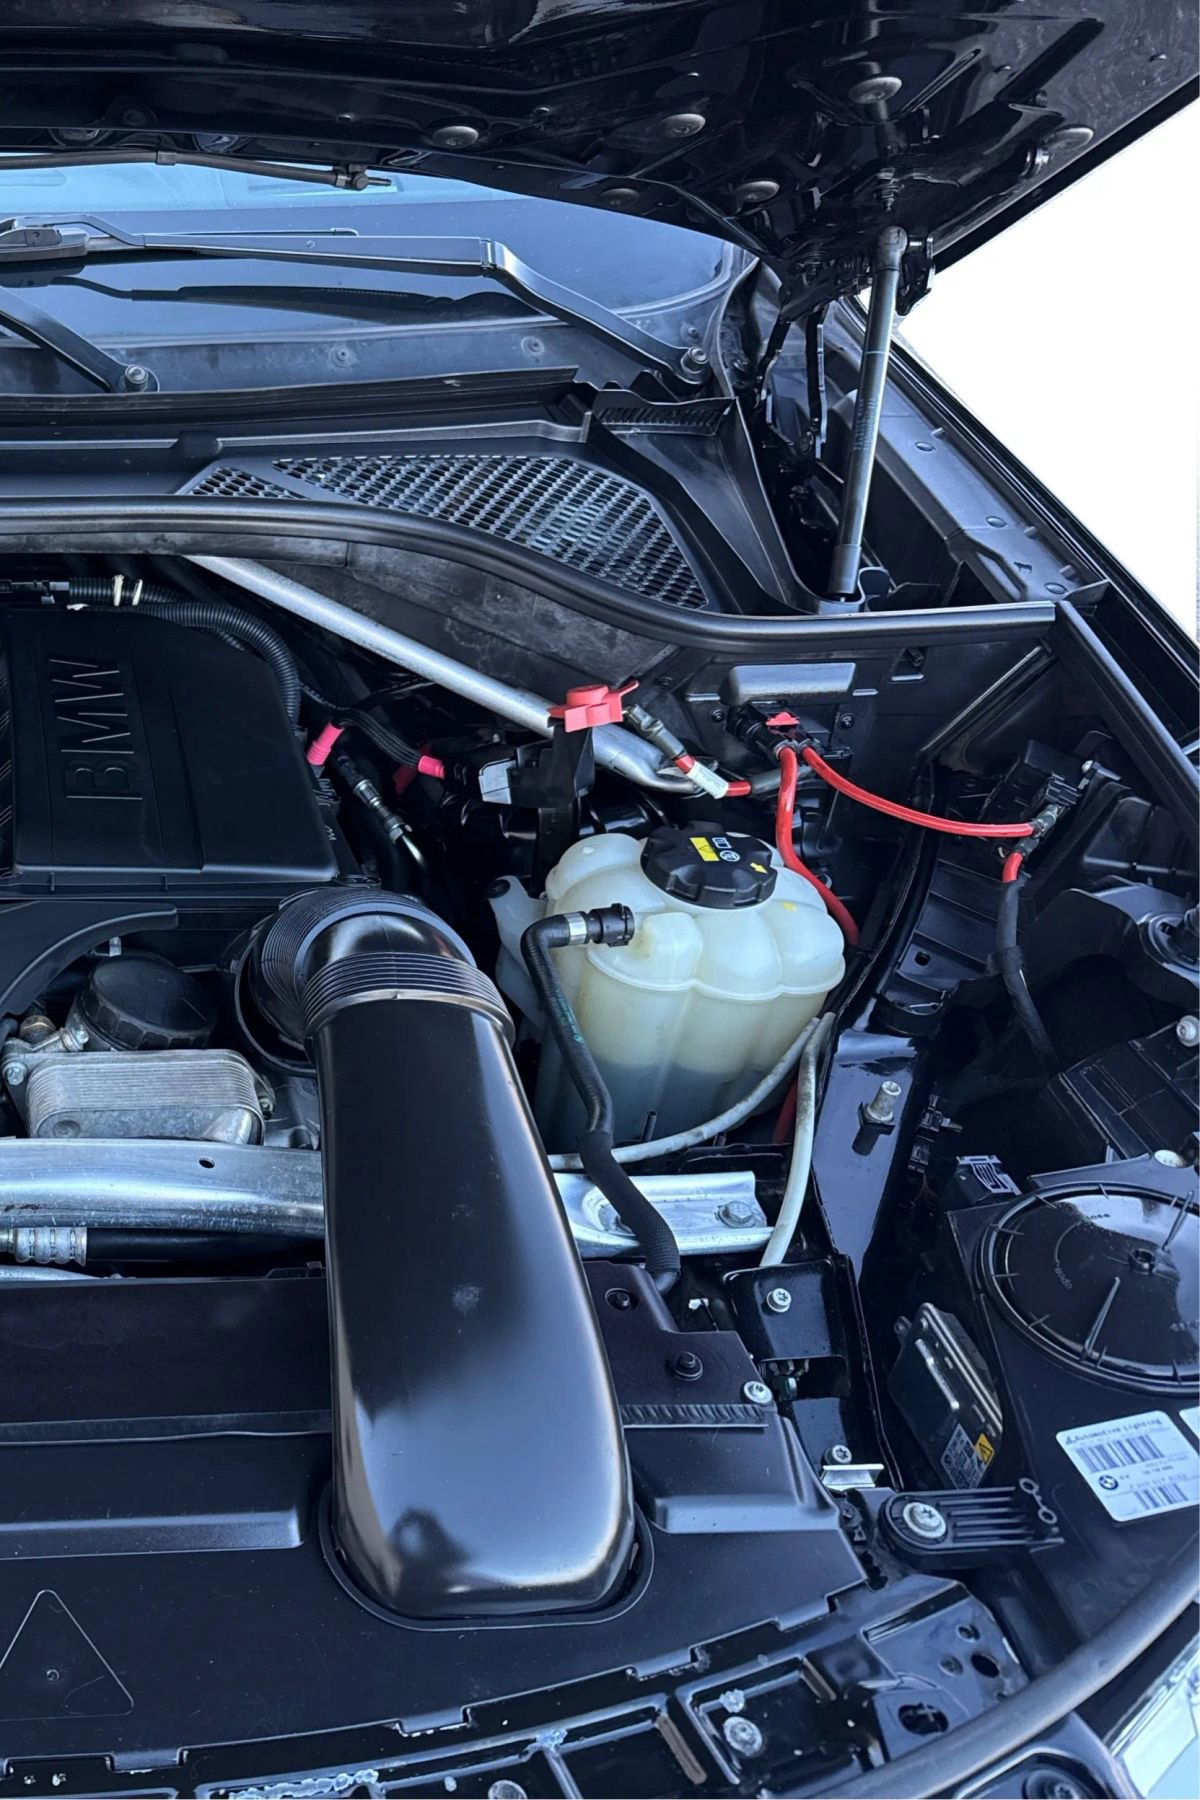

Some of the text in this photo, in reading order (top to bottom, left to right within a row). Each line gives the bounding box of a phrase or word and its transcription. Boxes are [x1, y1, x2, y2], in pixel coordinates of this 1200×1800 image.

[49, 658, 143, 800] BMW
[1074, 1418, 1163, 1442] Automotive Lighting
